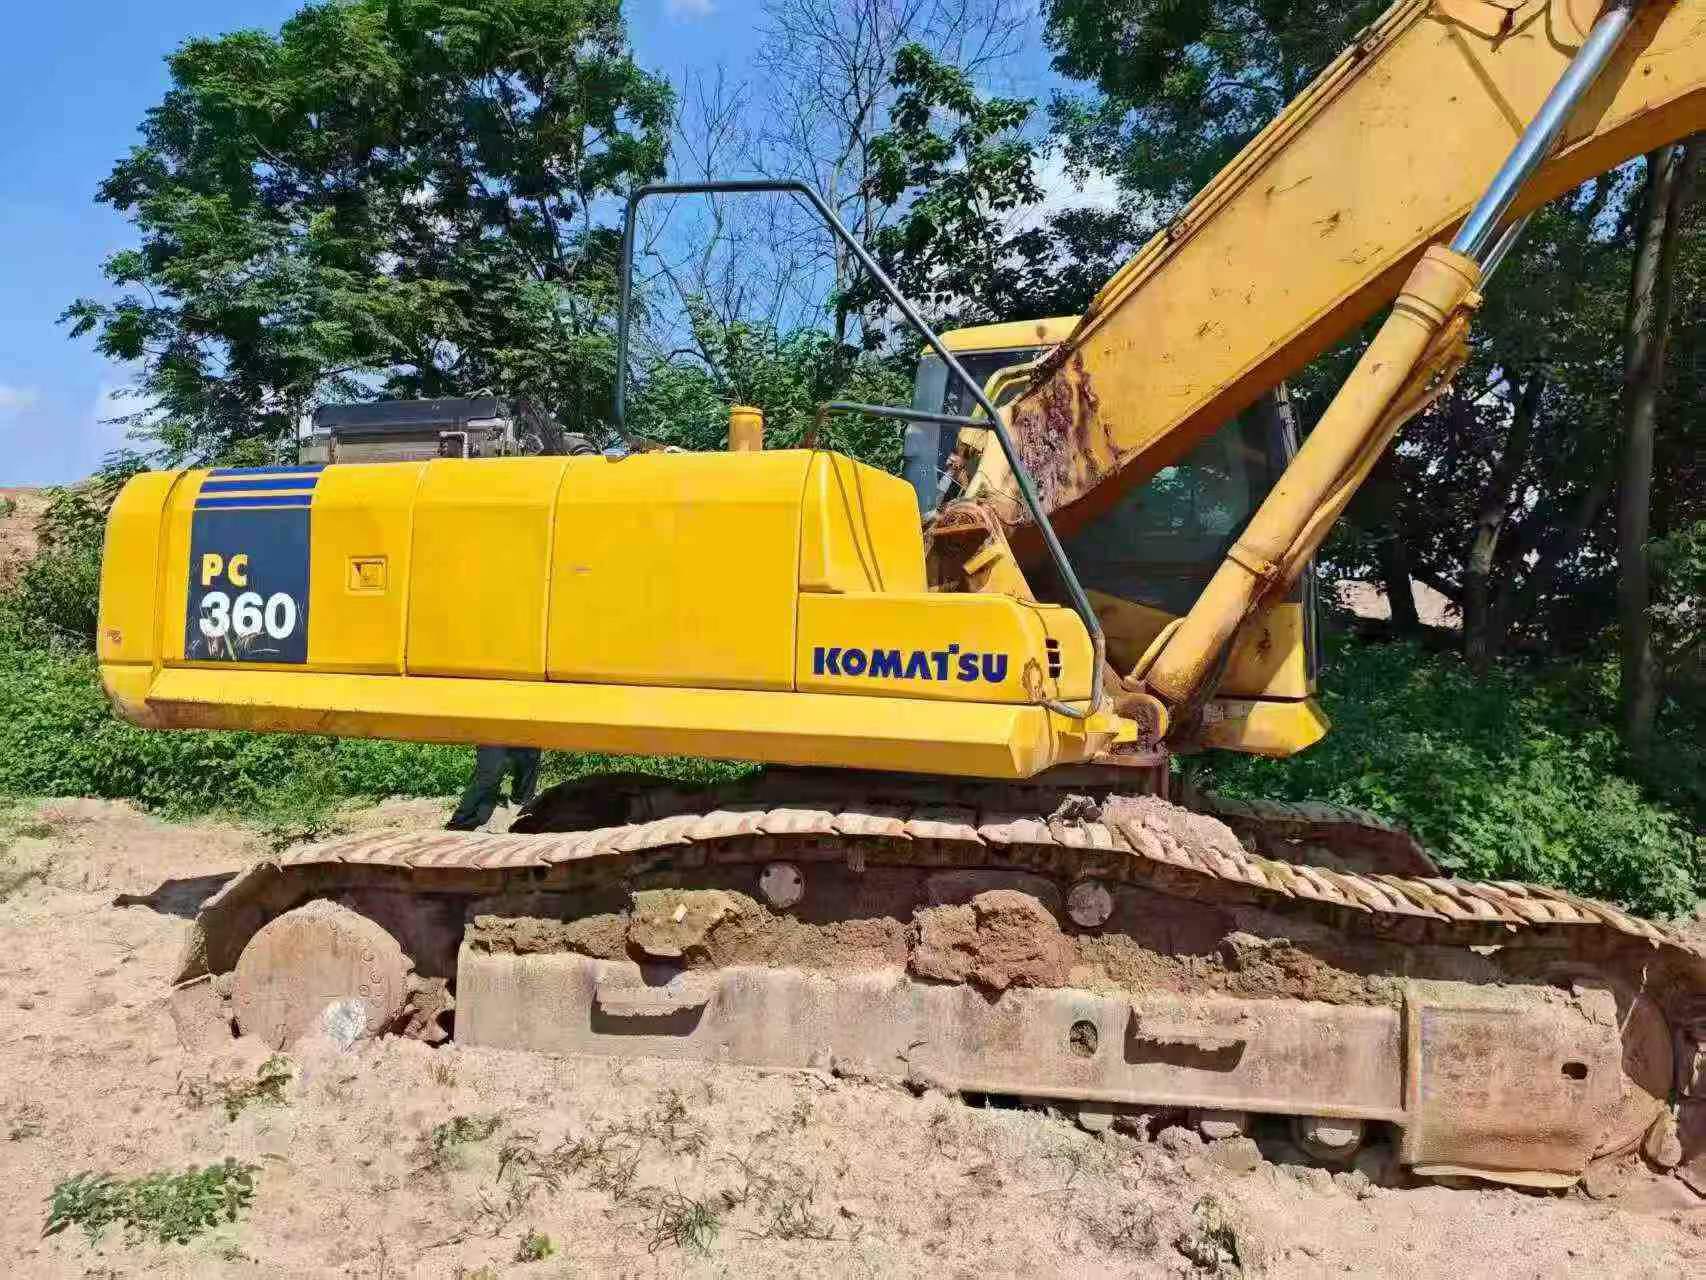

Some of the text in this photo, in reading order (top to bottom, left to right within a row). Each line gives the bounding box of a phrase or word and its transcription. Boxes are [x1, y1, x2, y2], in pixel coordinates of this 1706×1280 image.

[201, 553, 248, 586] PC
[199, 591, 296, 640] 360
[812, 643, 1008, 683] KOMATSU
